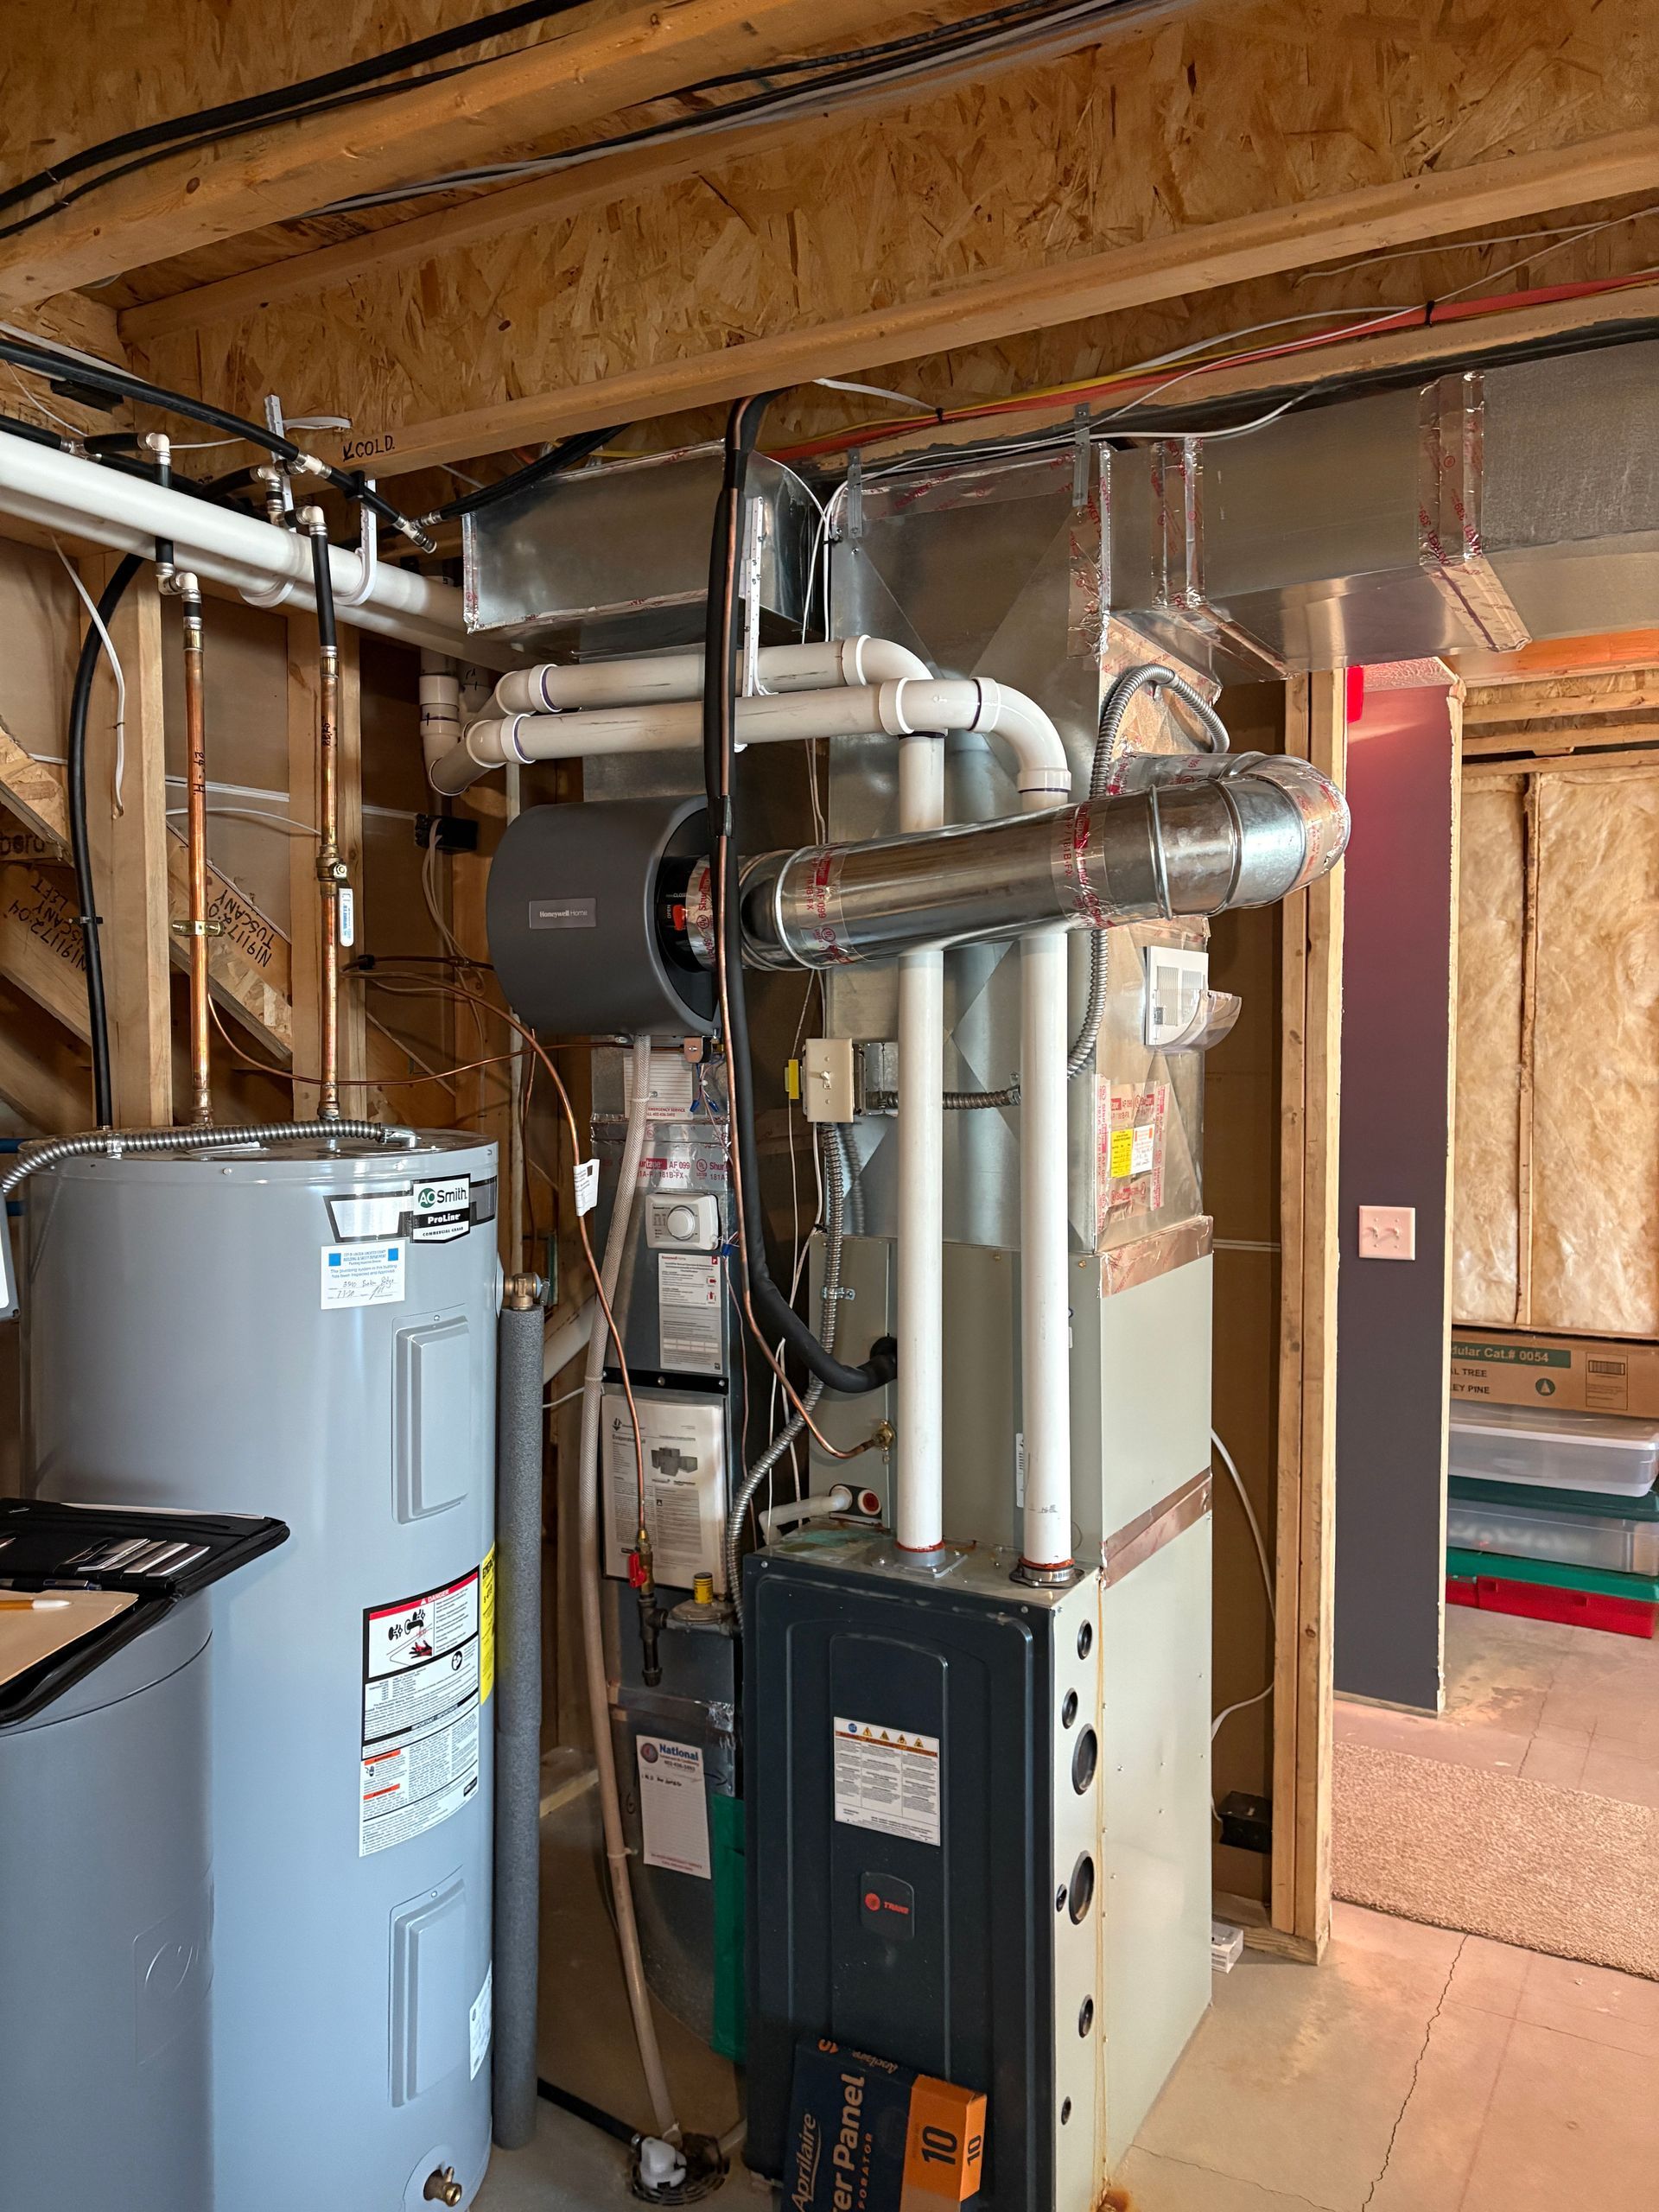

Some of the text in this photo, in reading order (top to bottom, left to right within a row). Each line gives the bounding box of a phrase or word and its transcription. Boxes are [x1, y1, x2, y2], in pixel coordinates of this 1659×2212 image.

[30, 879, 69, 912] LEFT
[539, 909, 569, 918] Honeywell
[817, 902, 827, 918] 099
[215, 889, 274, 950] TUSCANY
[418, 1191, 435, 1205] AO
[1519, 1351, 1549, 1363] 0054
[1463, 1369, 1487, 1377] TREE
[1468, 1385, 1490, 1394] PINE
[428, 1589, 449, 1602] DANGER
[659, 1744, 698, 1761] National
[832, 2074, 865, 2171] Panel
[921, 2125, 957, 2166] 10
[967, 2134, 982, 2166] 10
[791, 2113, 817, 2212] Aprilaire
